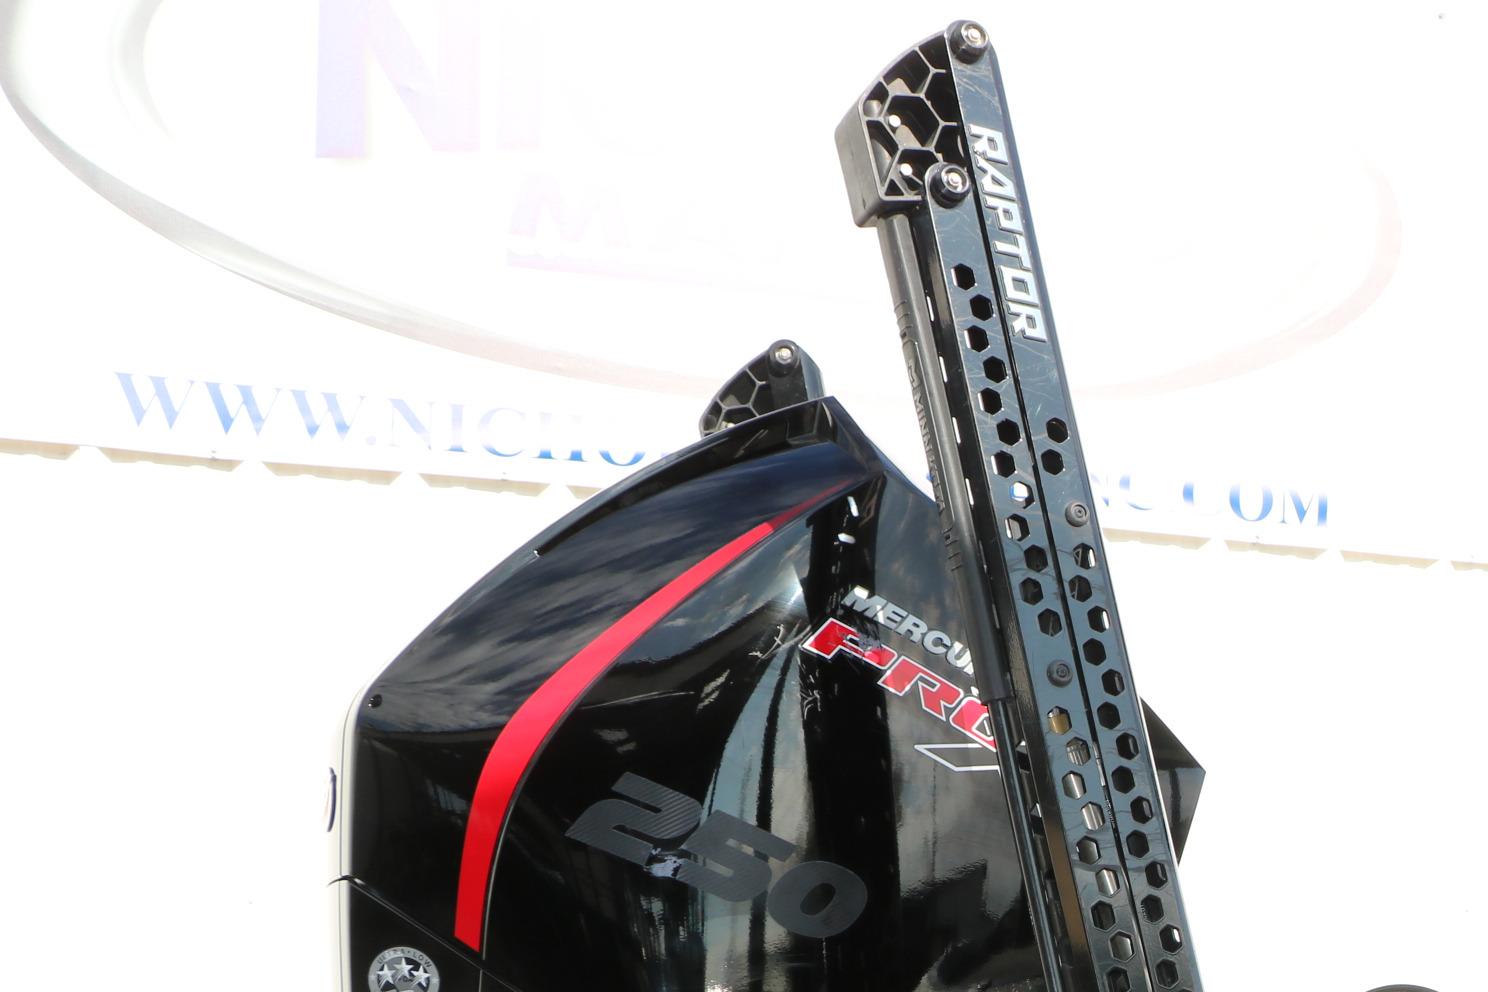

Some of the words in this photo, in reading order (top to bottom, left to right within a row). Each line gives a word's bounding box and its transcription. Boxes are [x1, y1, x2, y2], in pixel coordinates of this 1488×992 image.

[967, 123, 1049, 344] RAPTOR
[841, 585, 976, 677] MERCU
[564, 771, 869, 939] 250
